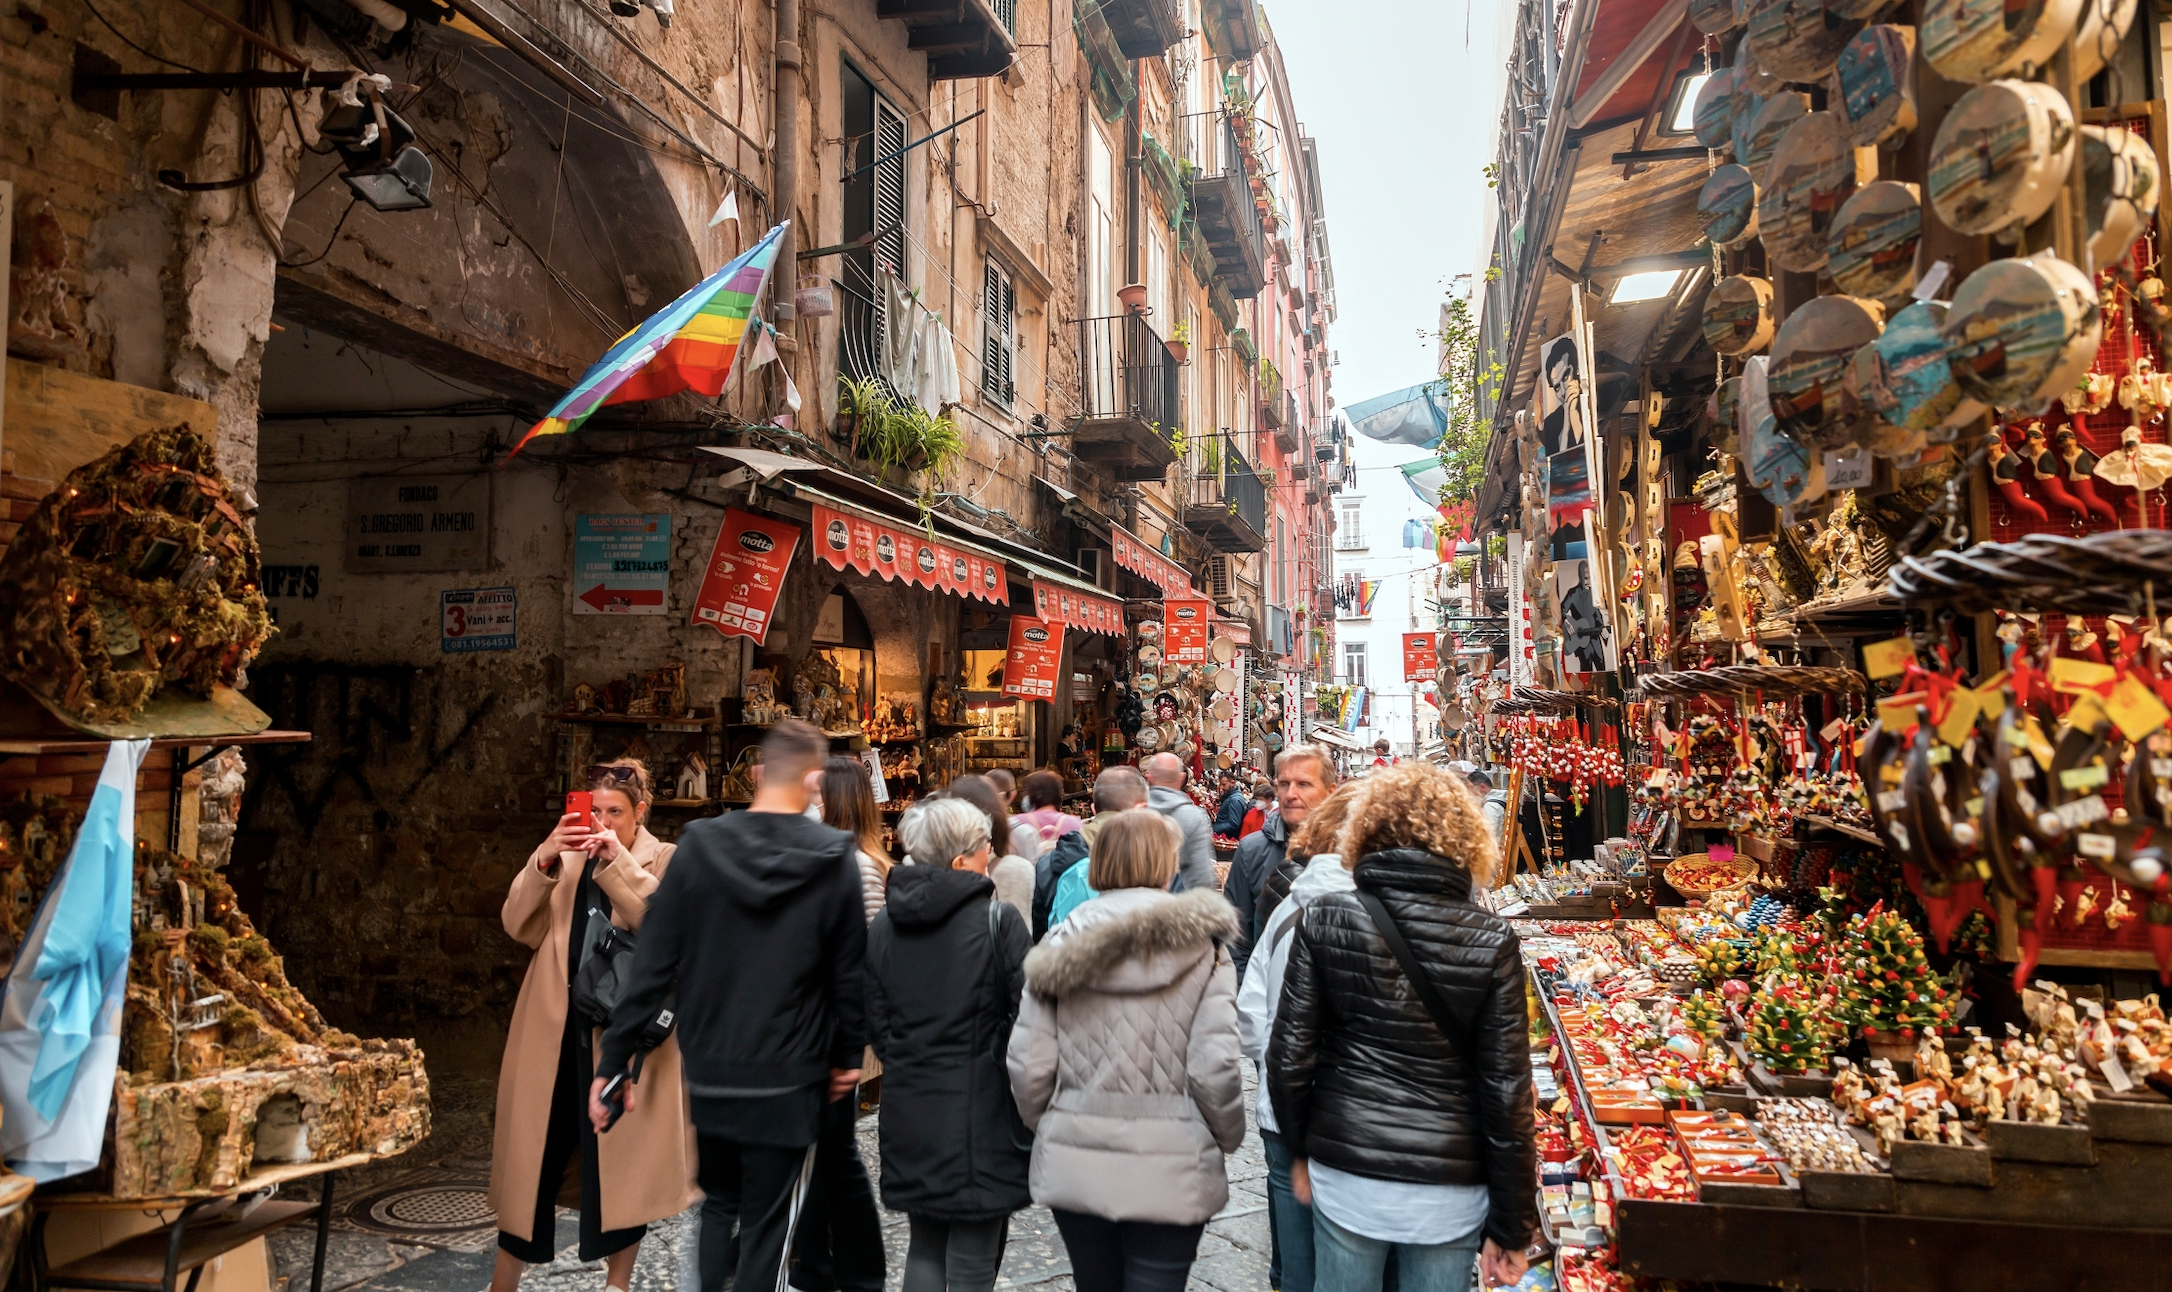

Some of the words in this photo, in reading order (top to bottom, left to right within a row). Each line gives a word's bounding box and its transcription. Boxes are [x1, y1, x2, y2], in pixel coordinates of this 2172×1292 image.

[398, 486, 438, 502] FONDACO
[360, 513, 423, 534] S.GREGORIO
[430, 512, 474, 532] ARMENO
[589, 518, 610, 526] BAGS
[611, 518, 644, 526] CENTER
[739, 535, 773, 551] motta
[828, 530, 848, 545] motta
[358, 545, 382, 558] QUART.
[385, 544, 421, 557] S.LORENZO
[877, 544, 895, 557] motta
[918, 555, 936, 568] motta
[478, 594, 512, 604] AFFITTO
[446, 606, 466, 637] 3
[467, 614, 485, 625] Vani
[496, 615, 512, 624] acc.
[451, 638, 514, 648] 081.19564531
